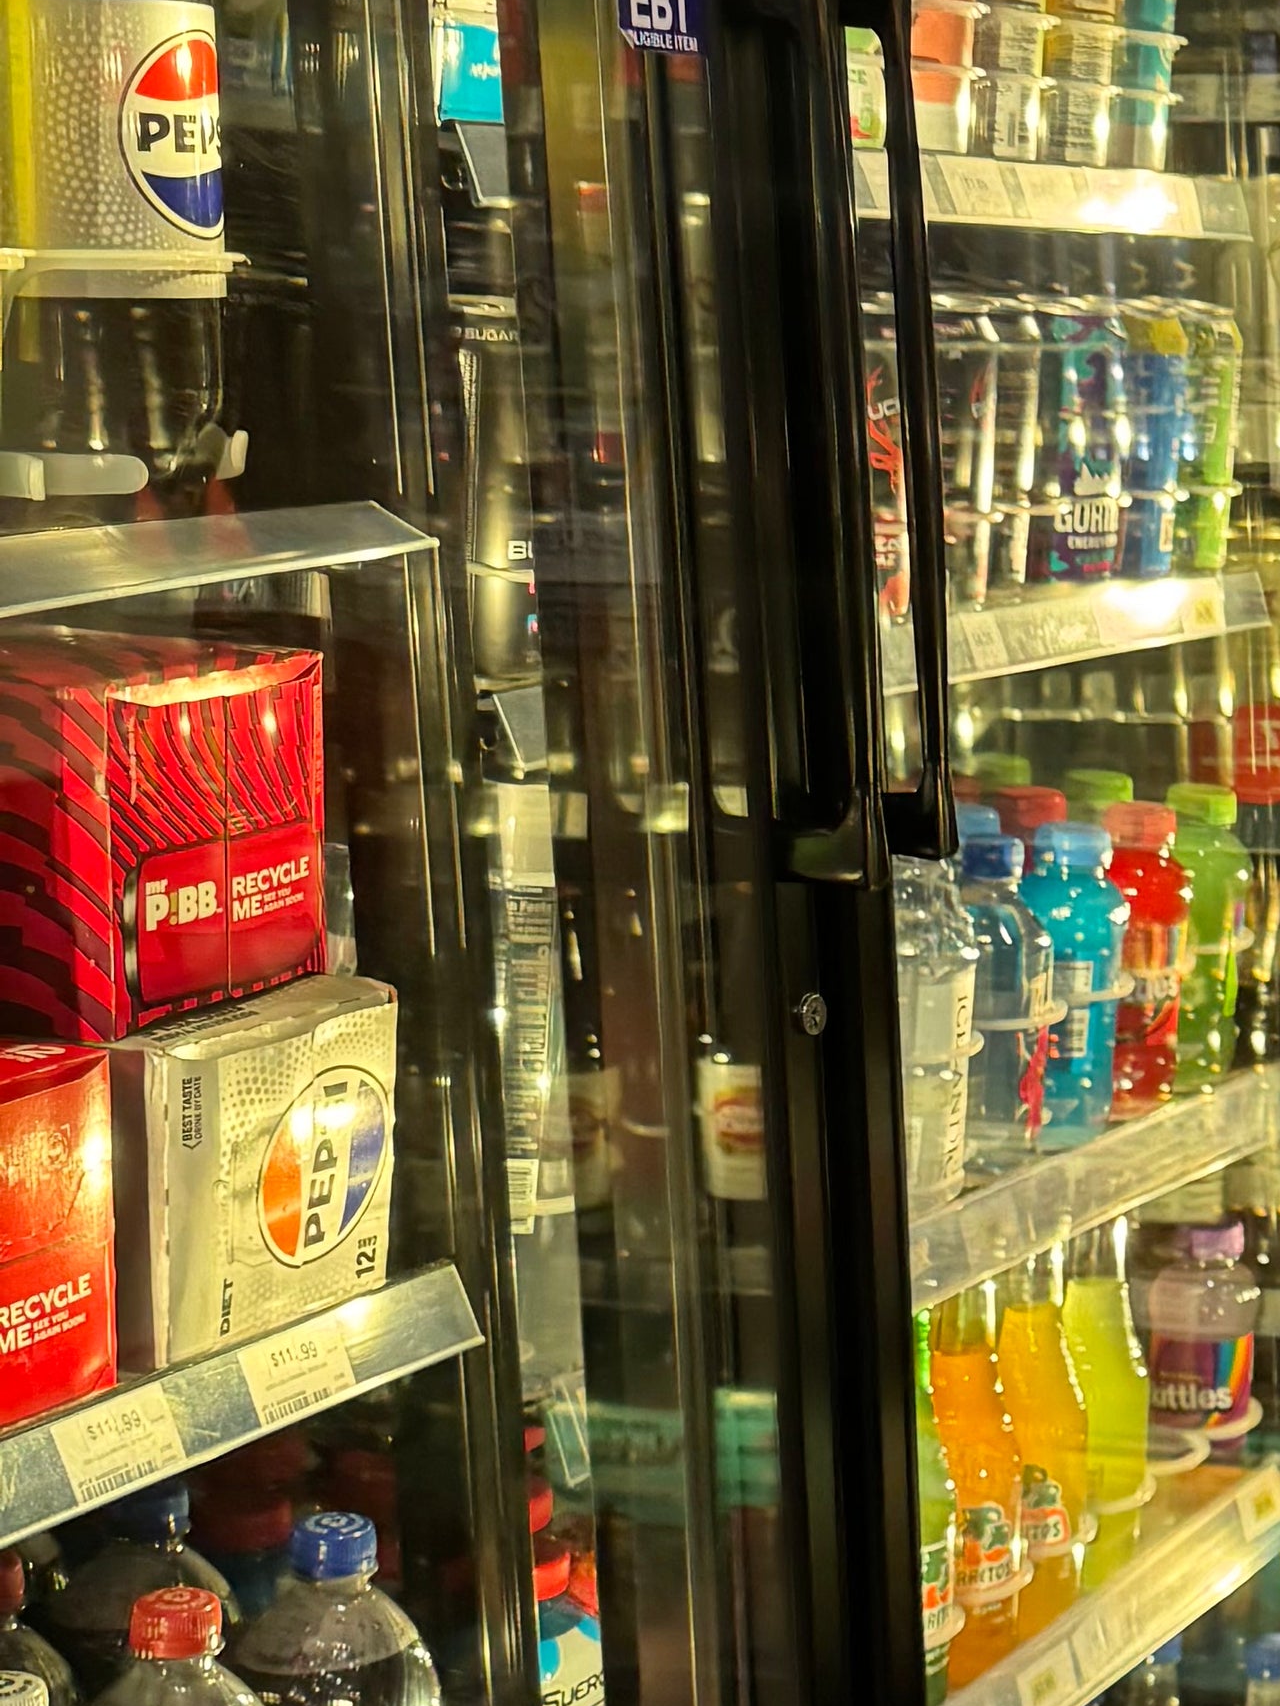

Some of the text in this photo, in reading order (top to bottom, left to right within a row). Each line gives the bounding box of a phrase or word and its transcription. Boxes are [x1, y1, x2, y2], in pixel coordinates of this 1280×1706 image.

[145, 878, 169, 894] mr
[232, 856, 310, 899] RECYCLE
[232, 895, 264, 922] ME
[940, 993, 969, 1182] ICEANDIC
[181, 1077, 193, 1142] BEST TASTE
[303, 1081, 348, 1249] PEPI
[356, 1247, 376, 1279] 12
[0, 1272, 92, 1328] RECYCLE
[220, 1278, 234, 1337] DIET
[271, 1341, 318, 1368] $11.99
[86, 1409, 142, 1441] $11.99
